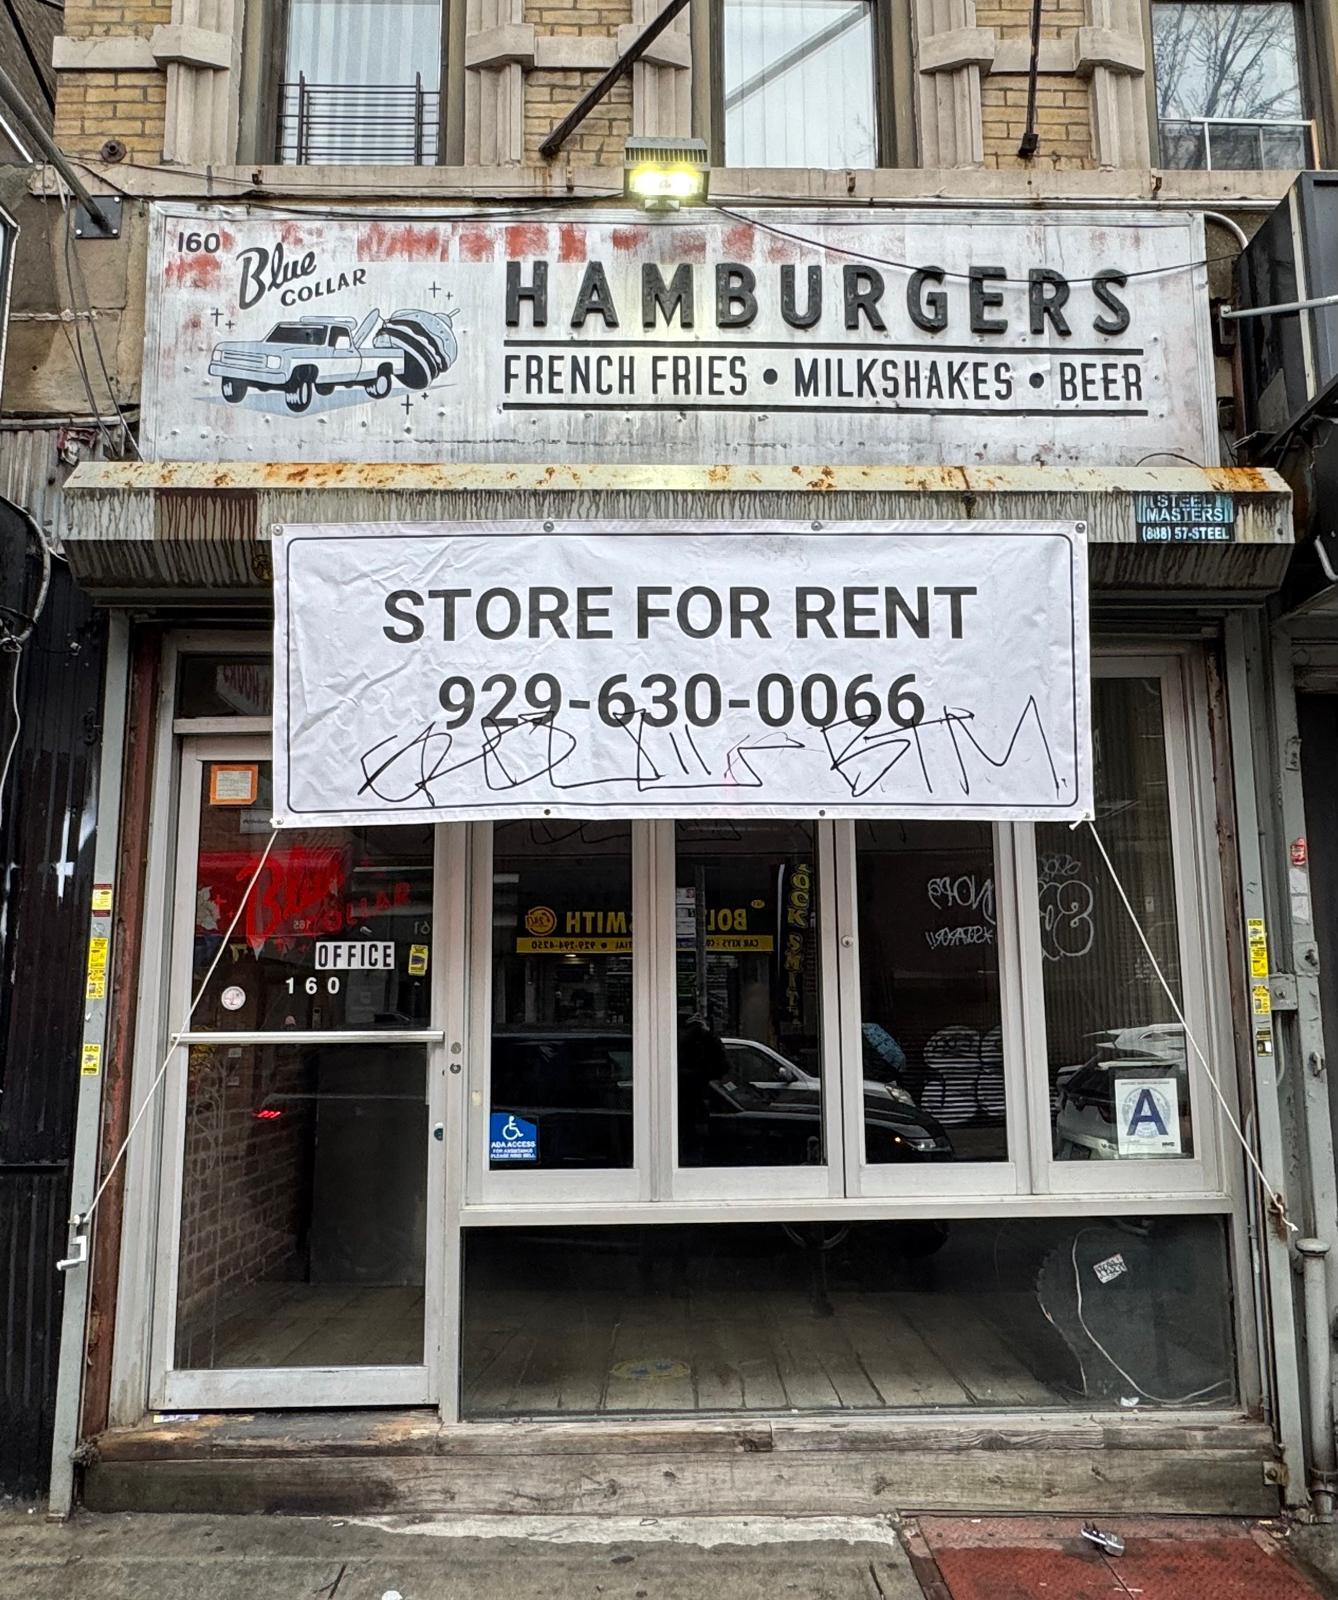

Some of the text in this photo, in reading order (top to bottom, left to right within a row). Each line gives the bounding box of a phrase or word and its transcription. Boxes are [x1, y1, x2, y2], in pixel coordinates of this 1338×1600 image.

[179, 232, 220, 254] 160
[237, 242, 316, 310] Blue
[281, 268, 366, 306] COLLAR
[506, 260, 1131, 336] HAMBURGERS
[504, 355, 1142, 401] FRENCH FRIES MILKSHAKES BEER
[1146, 508, 1223, 522] MASTERS
[1157, 493, 1213, 508] STEEL
[1174, 526, 1230, 540] 57-STEEL
[383, 586, 977, 643] STORE FOR RENT
[438, 673, 925, 730] 929-630-0066
[318, 944, 392, 968] OFFICE
[285, 977, 340, 995] 160
[1127, 1088, 1169, 1136] A
